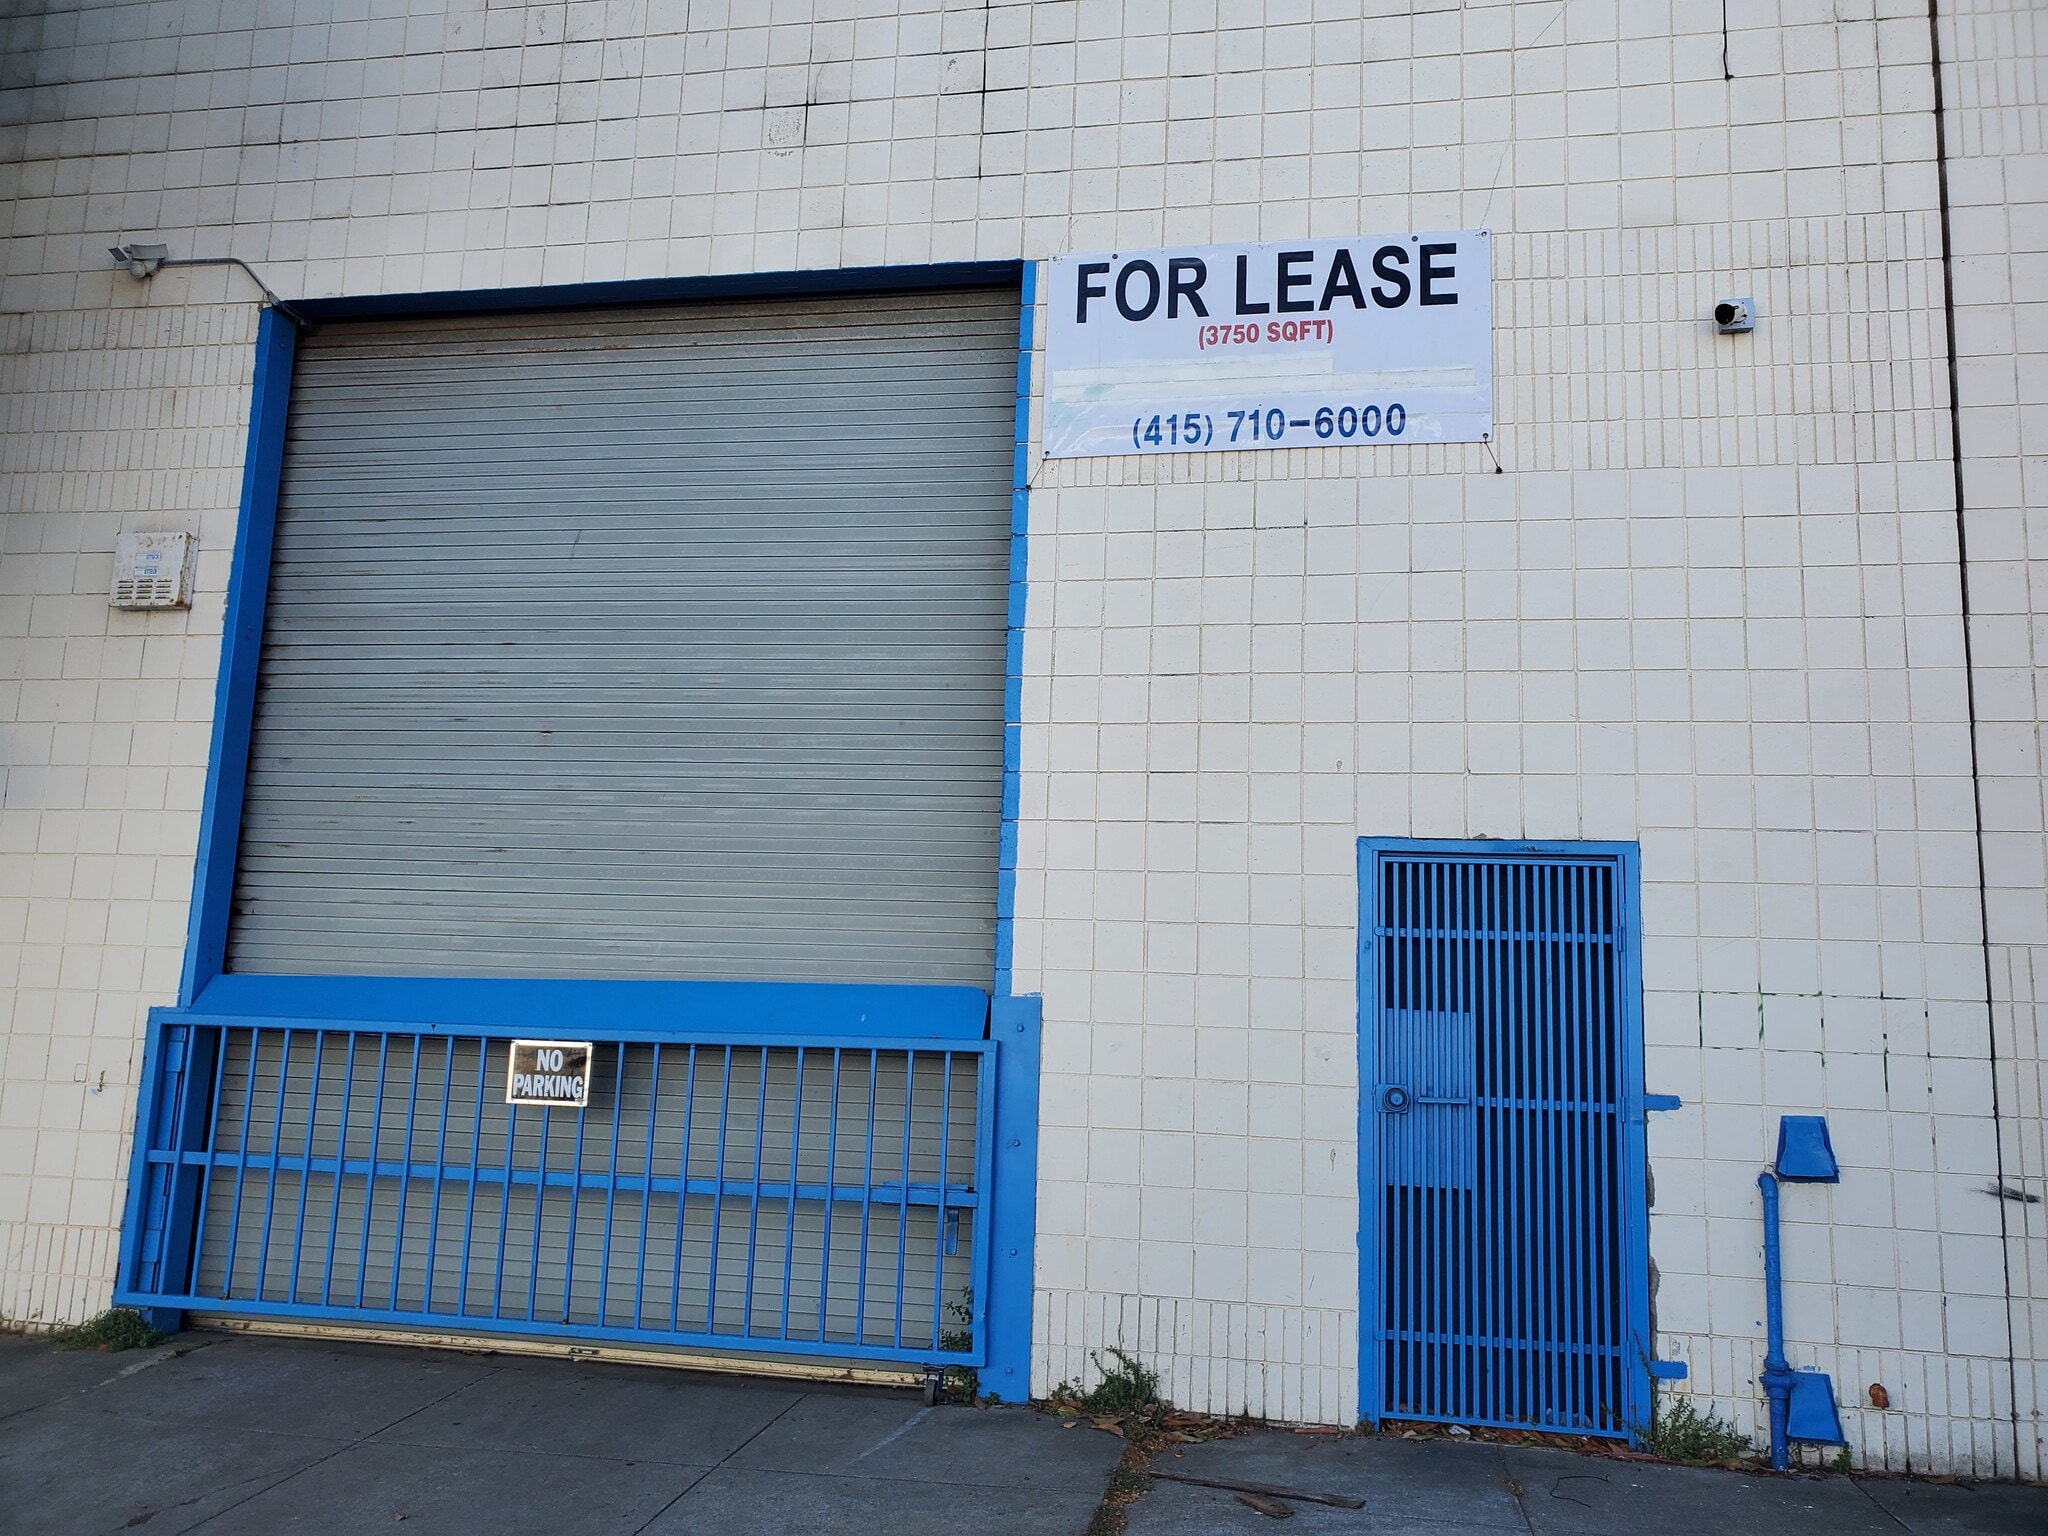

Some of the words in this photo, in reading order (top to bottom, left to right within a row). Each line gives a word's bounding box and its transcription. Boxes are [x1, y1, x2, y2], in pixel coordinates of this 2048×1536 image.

[1076, 257, 1209, 324] FOR
[1236, 242, 1458, 316] LEASE
[1198, 322, 1259, 350] (3750
[1267, 319, 1334, 345] SQFT)
[1132, 413, 1213, 449] (415)
[1228, 403, 1406, 443] 710-6000
[537, 1049, 563, 1072] NO
[513, 1073, 583, 1098] PARKING
